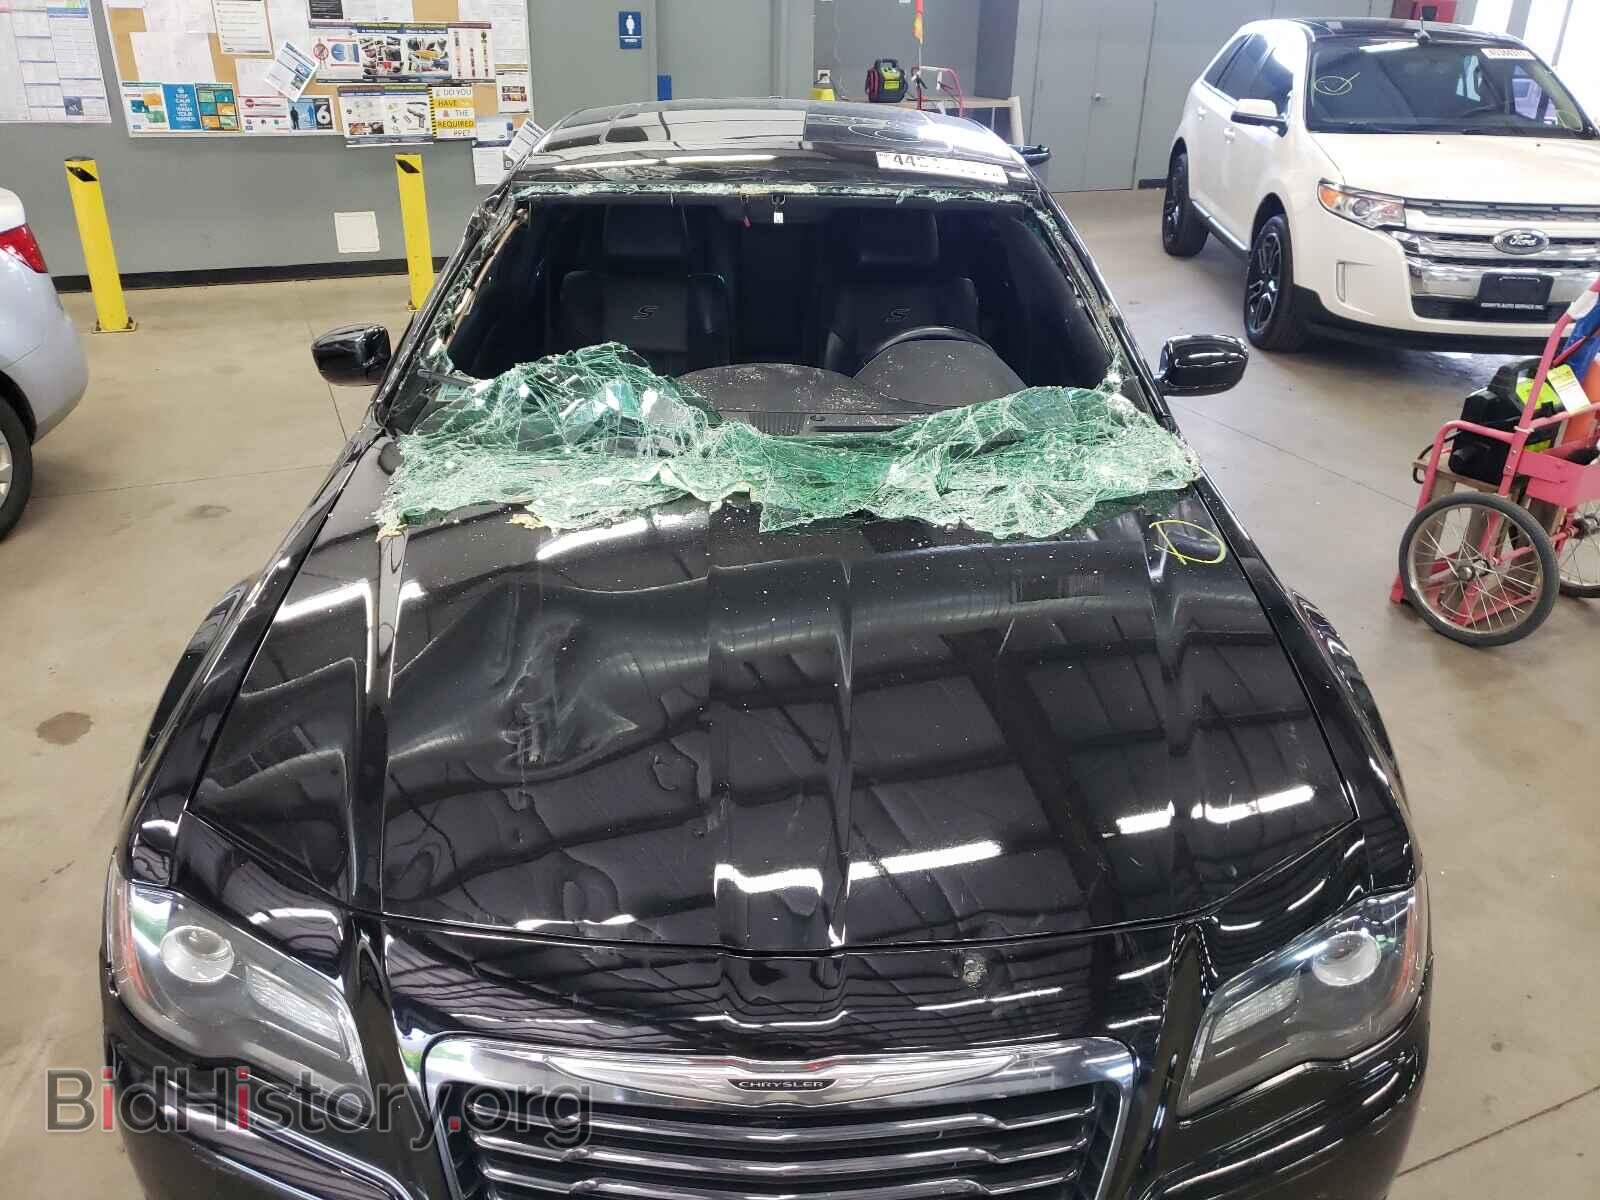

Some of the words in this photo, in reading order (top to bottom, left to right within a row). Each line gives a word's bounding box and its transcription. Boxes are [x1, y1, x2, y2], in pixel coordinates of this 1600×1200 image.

[455, 109, 469, 117] THE
[437, 120, 474, 128] REQUIRED
[1509, 233, 1537, 247] Ford
[738, 1081, 824, 1089] CHRYSLER
